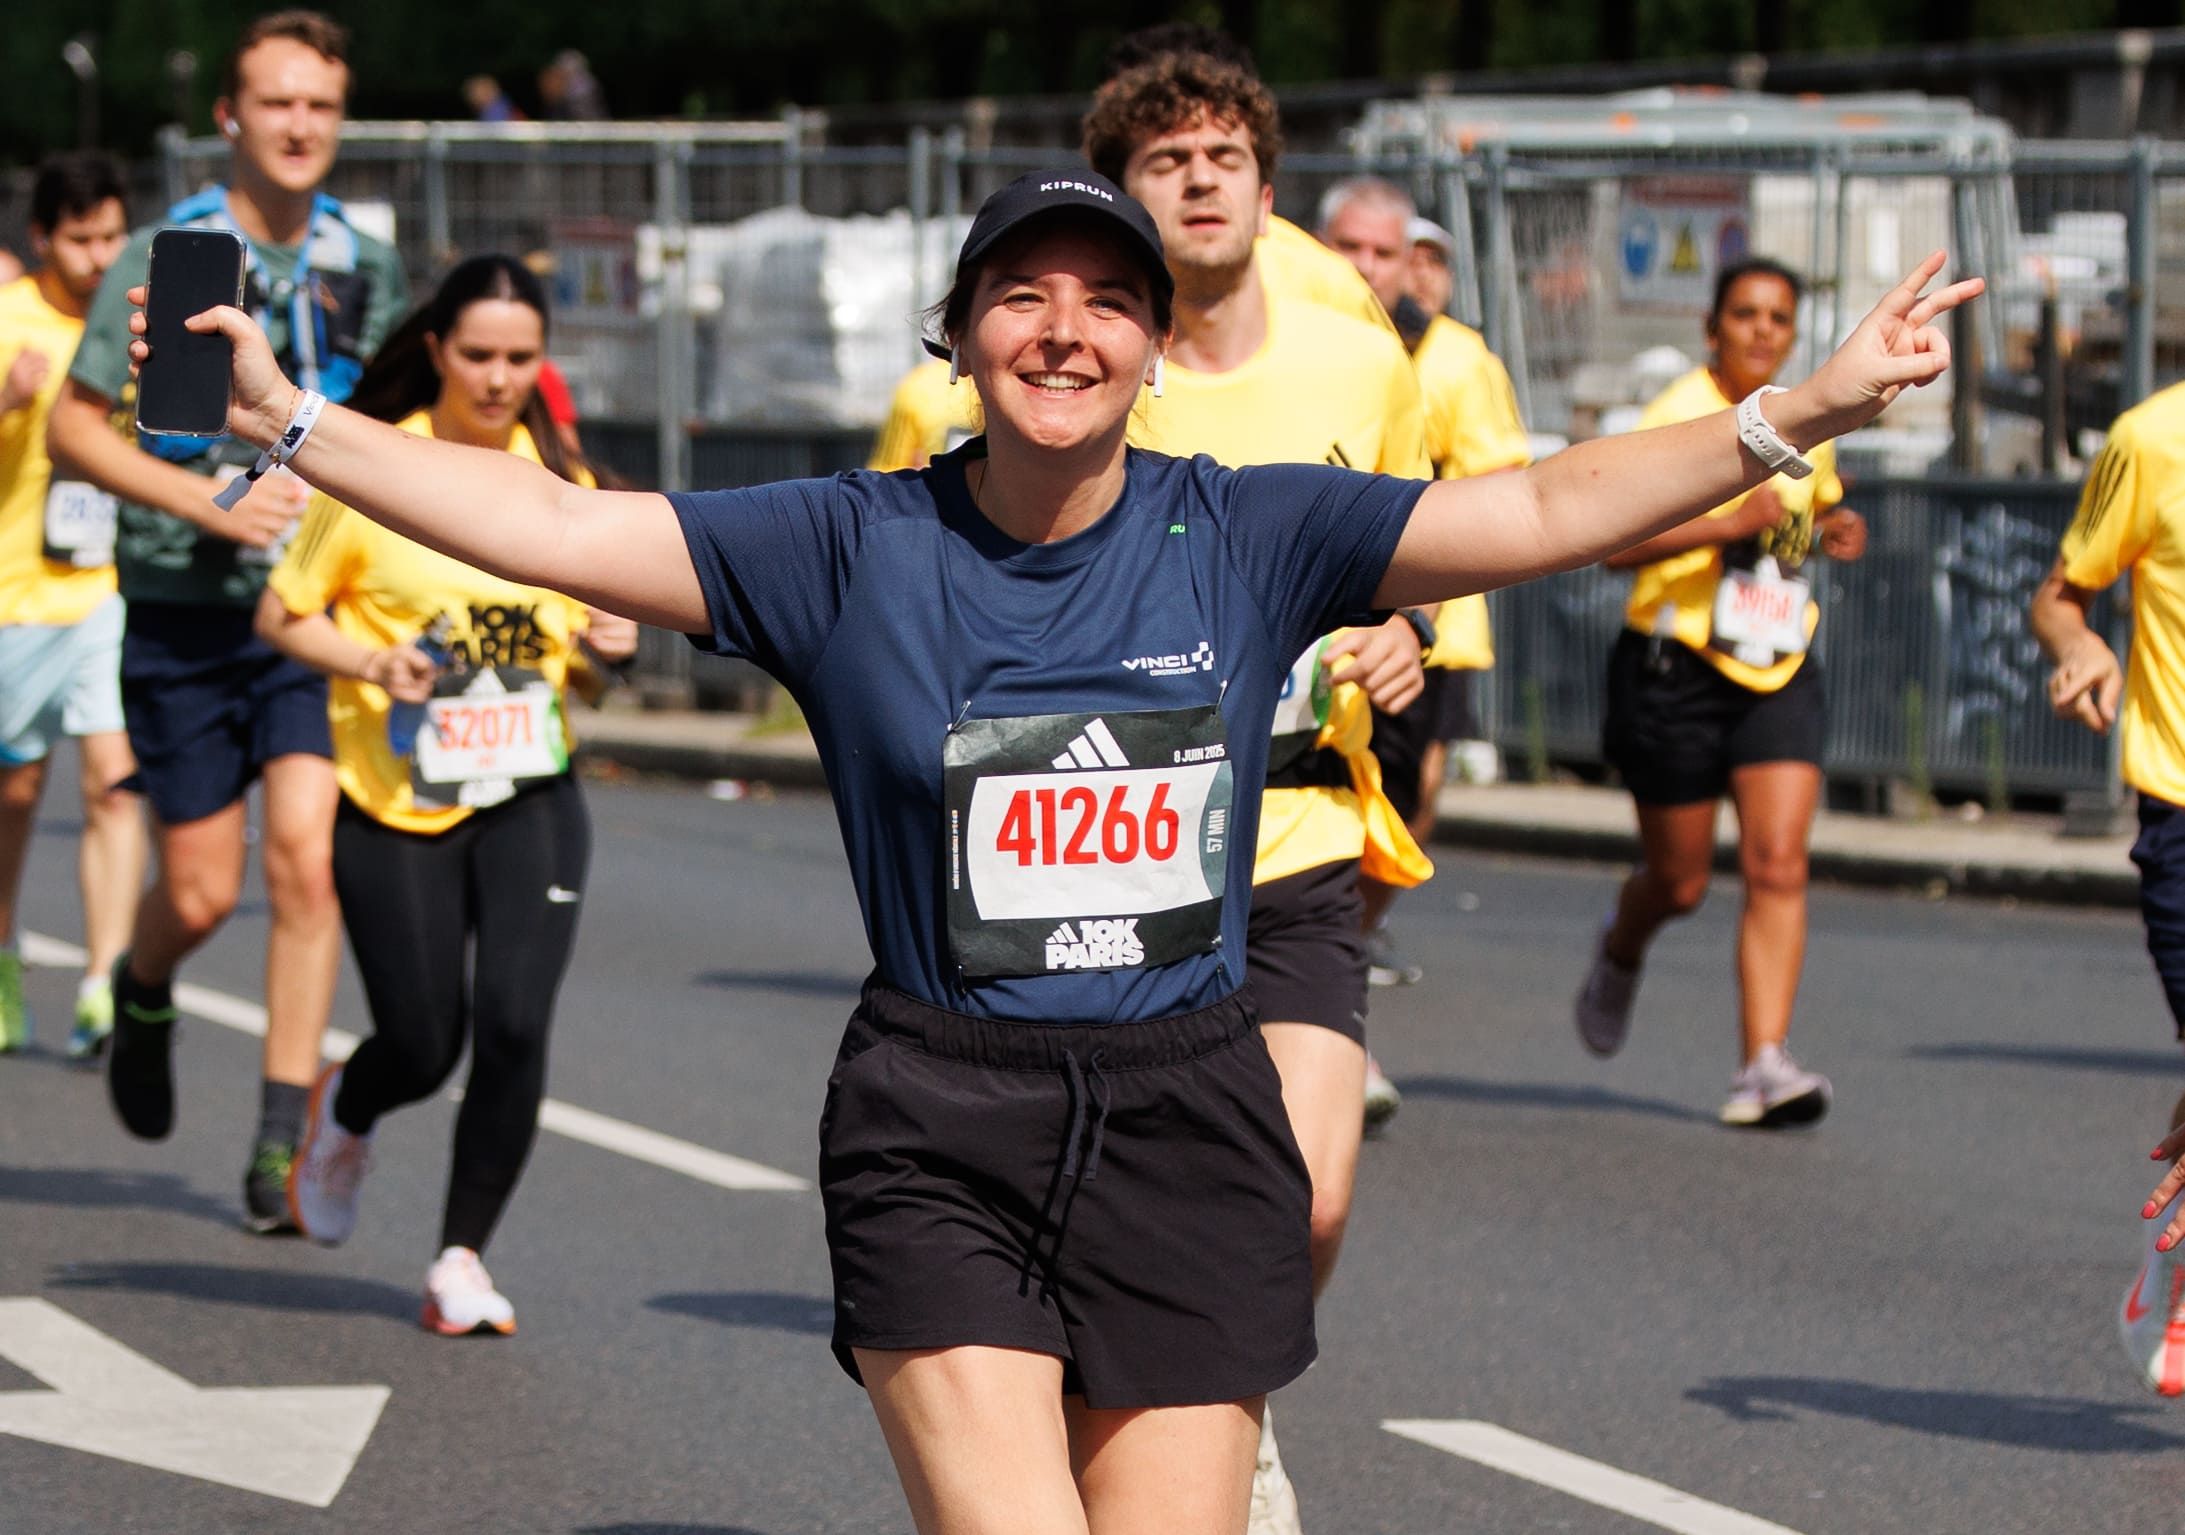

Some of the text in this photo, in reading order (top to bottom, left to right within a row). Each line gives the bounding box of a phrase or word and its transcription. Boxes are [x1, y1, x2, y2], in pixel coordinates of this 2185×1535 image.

[1040, 181, 1113, 202] KIPRUN
[451, 631, 548, 670] ARIS
[1121, 653, 1189, 671] VINCI
[1173, 749, 1181, 764] 8
[1204, 743, 1226, 760] 2025
[996, 782, 1179, 866] 41266
[1206, 809, 1226, 854] 57 MIN
[1079, 918, 1143, 945] 10K
[1045, 943, 1145, 970] PARIS
